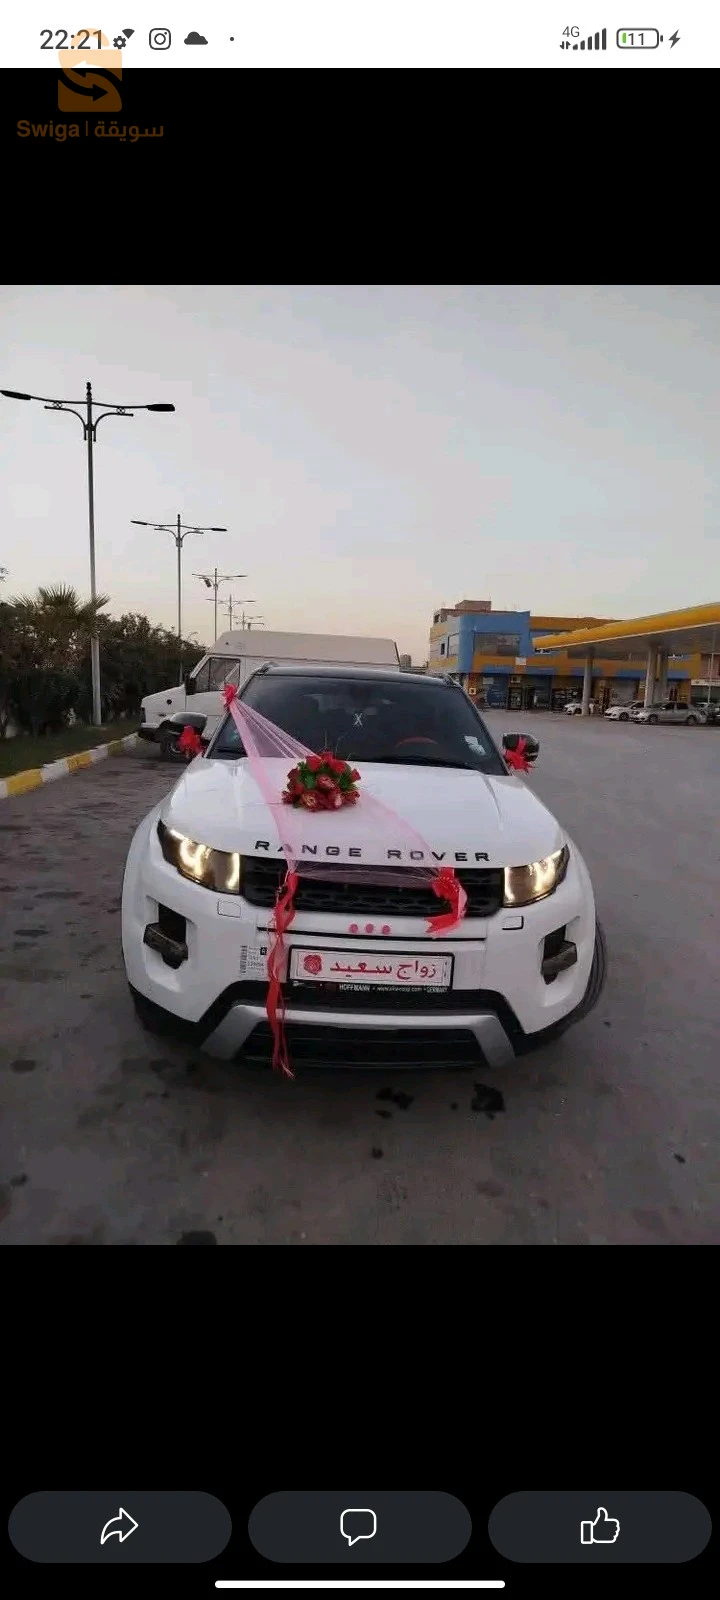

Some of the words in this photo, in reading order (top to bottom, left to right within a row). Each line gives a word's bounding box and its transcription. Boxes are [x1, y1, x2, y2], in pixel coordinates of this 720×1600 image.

[254, 840, 362, 857] RANGE
[387, 849, 491, 862] ROVER
[330, 961, 393, 978] سعيد
[396, 960, 437, 980] زواج
